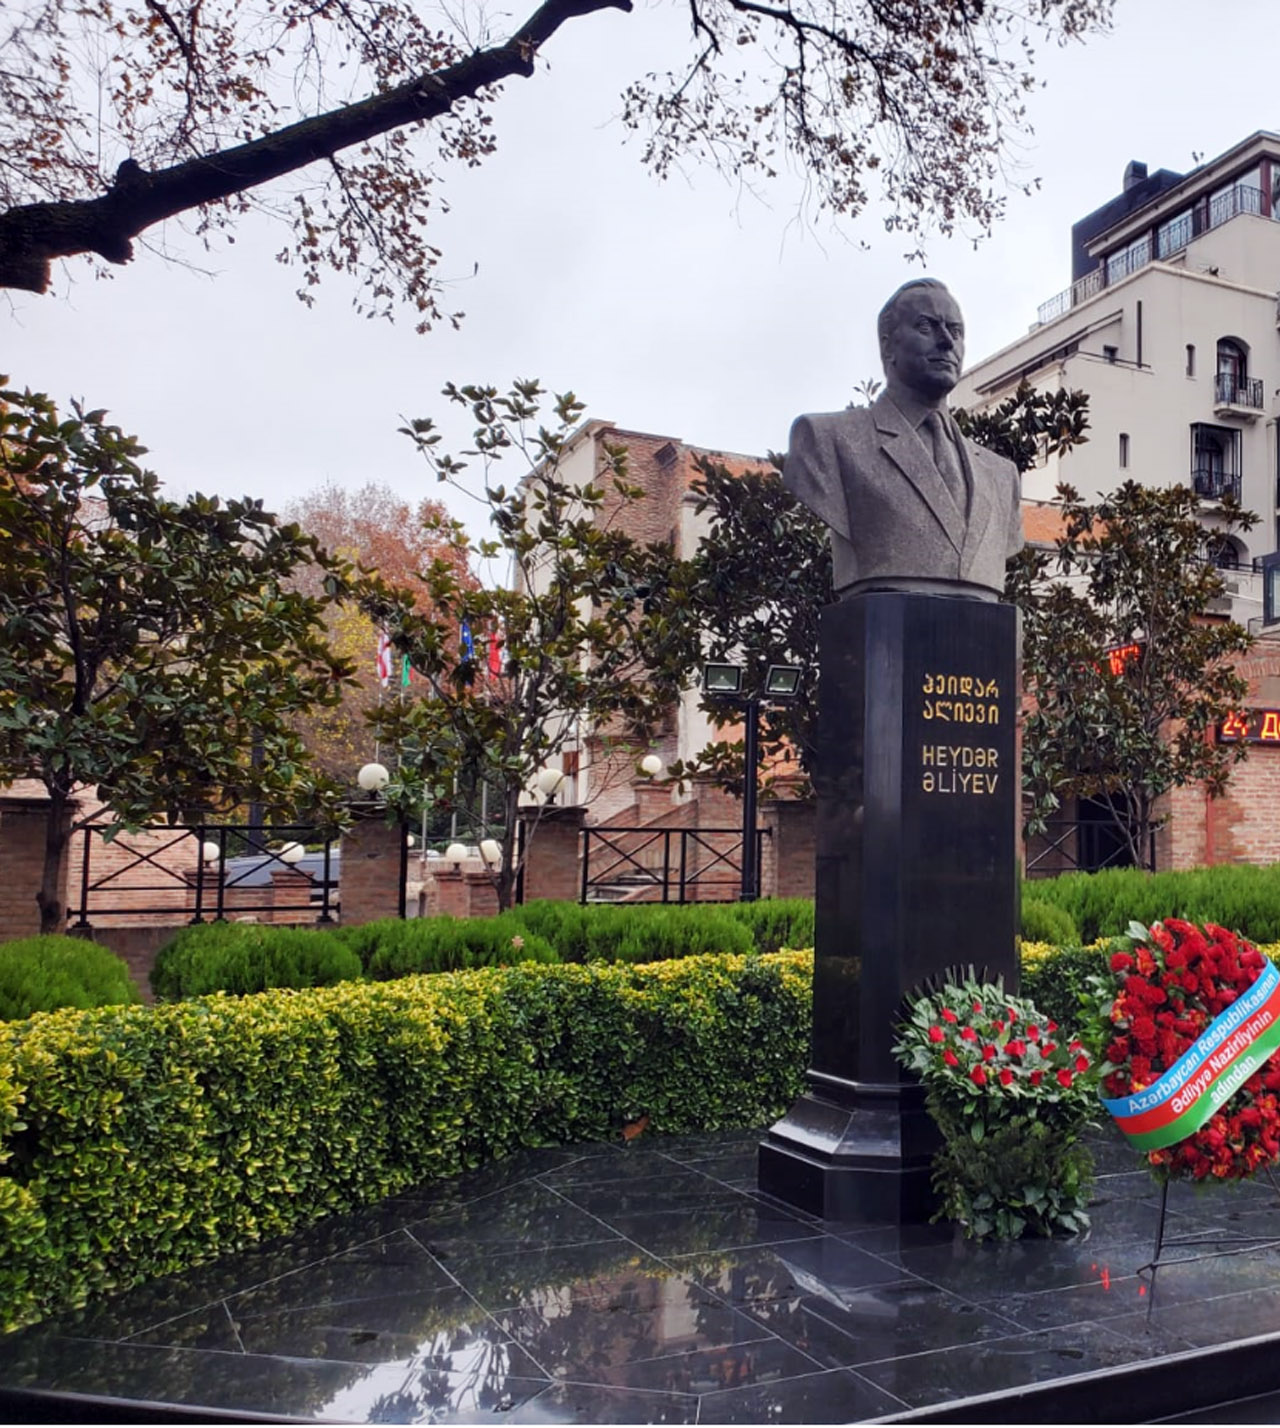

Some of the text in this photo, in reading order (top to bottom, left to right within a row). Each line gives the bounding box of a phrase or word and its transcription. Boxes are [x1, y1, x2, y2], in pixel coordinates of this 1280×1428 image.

[922, 673, 999, 698] ჰეიდარ
[922, 700, 999, 724] ალიევი
[922, 745, 999, 768] HEYDƏR
[922, 769, 999, 794] ƏLİYEV
[1171, 1010, 1273, 1113] Ədliyyə Nazirliyinin
[1128, 1052, 1200, 1114] Azərbaycan
[1210, 1055, 1256, 1104] adından
